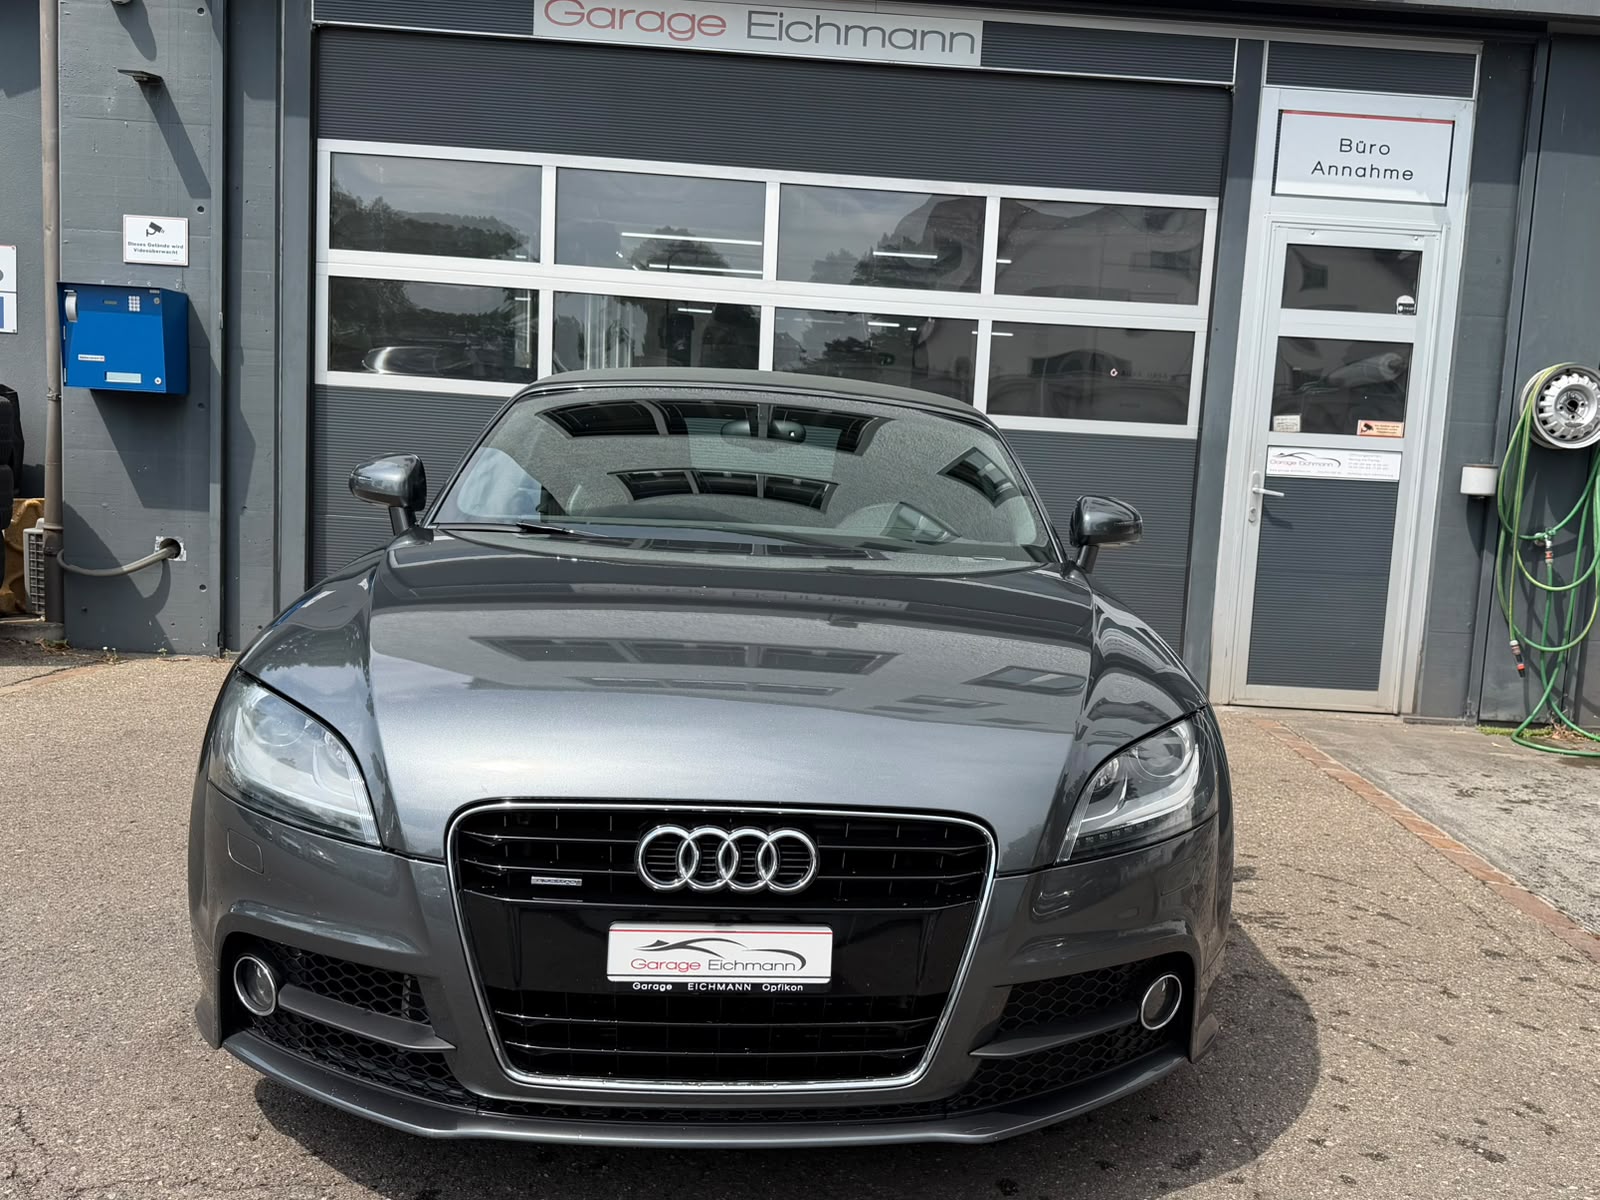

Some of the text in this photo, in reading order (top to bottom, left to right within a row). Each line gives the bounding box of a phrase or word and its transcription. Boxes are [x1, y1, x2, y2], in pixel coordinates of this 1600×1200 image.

[543, 0, 976, 55] Garage Eichmann
[1339, 138, 1390, 155] Büro
[1311, 160, 1413, 180] Annahme
[631, 958, 796, 973] Garage Eichmann
[632, 982, 804, 992] Garage EICHMANN Opfikon
